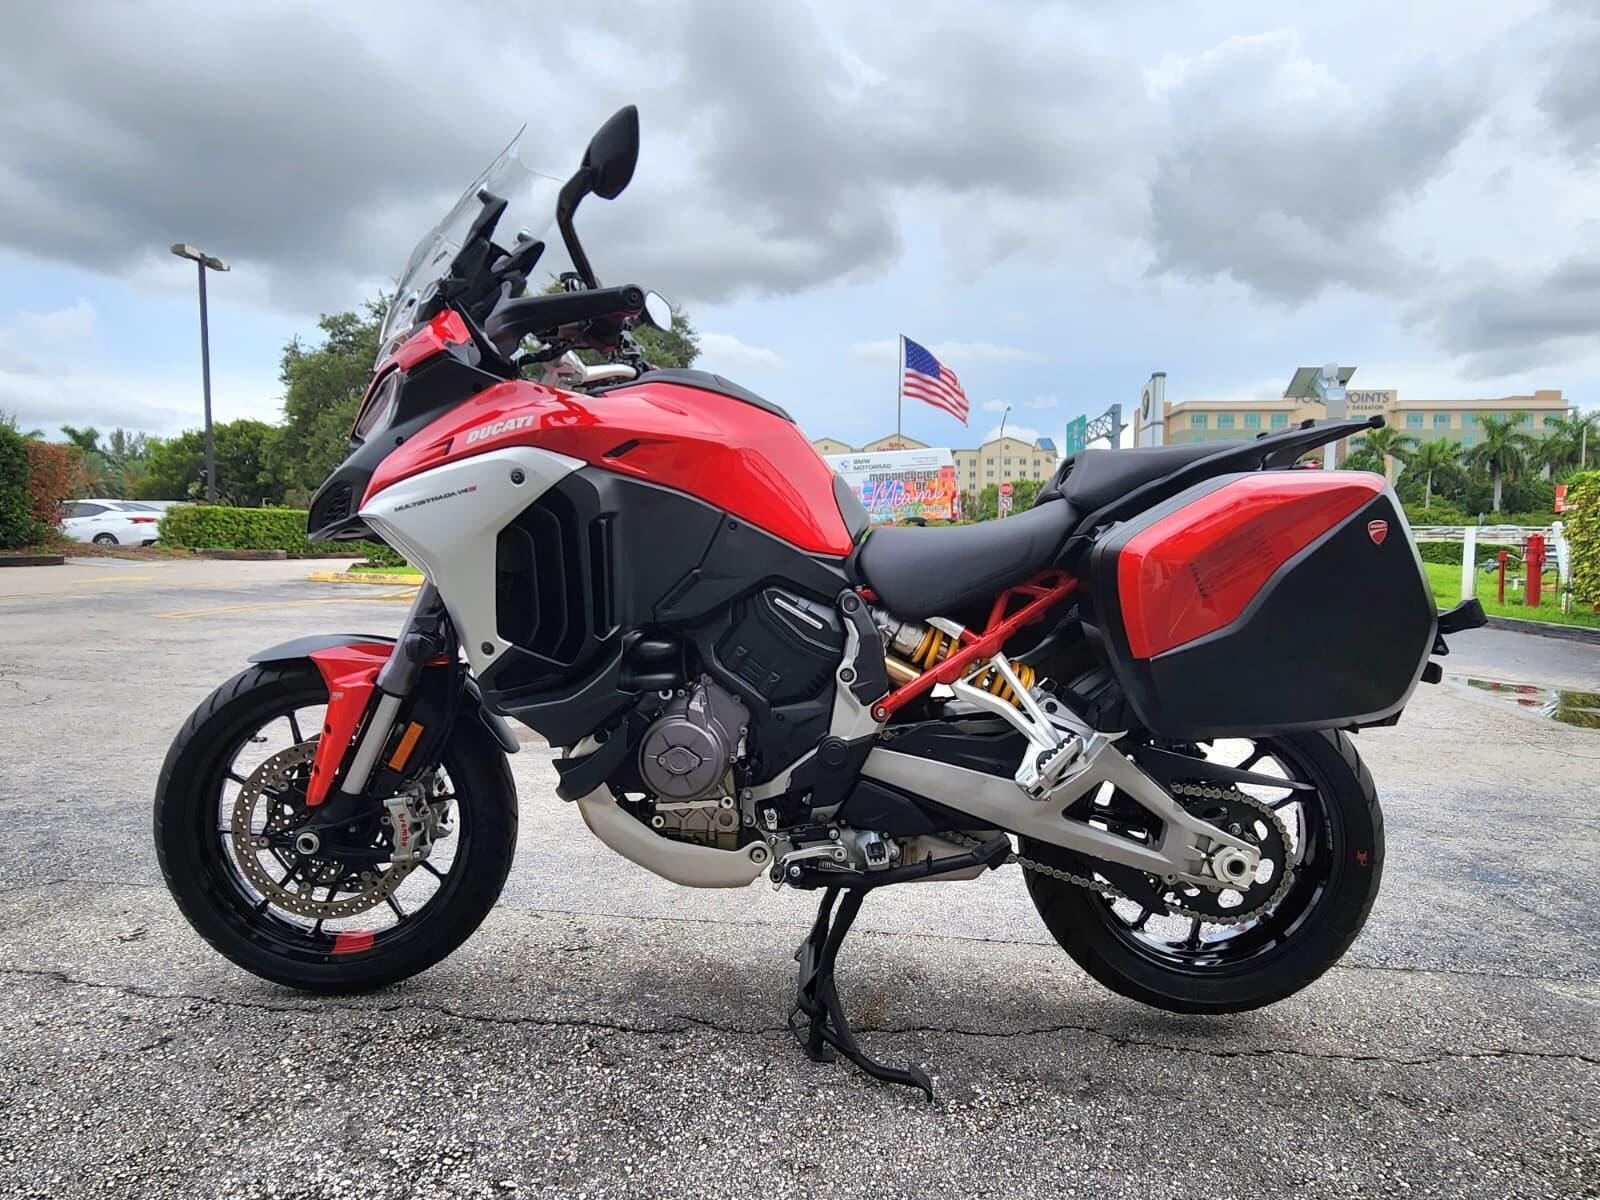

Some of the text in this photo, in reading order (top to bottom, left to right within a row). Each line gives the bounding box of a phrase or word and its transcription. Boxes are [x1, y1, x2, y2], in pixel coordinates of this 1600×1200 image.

[466, 415, 534, 444] DUCATI
[394, 492, 457, 512] MULTISTRADA
[870, 479, 944, 513] Miami
[398, 812, 409, 847] brembo
